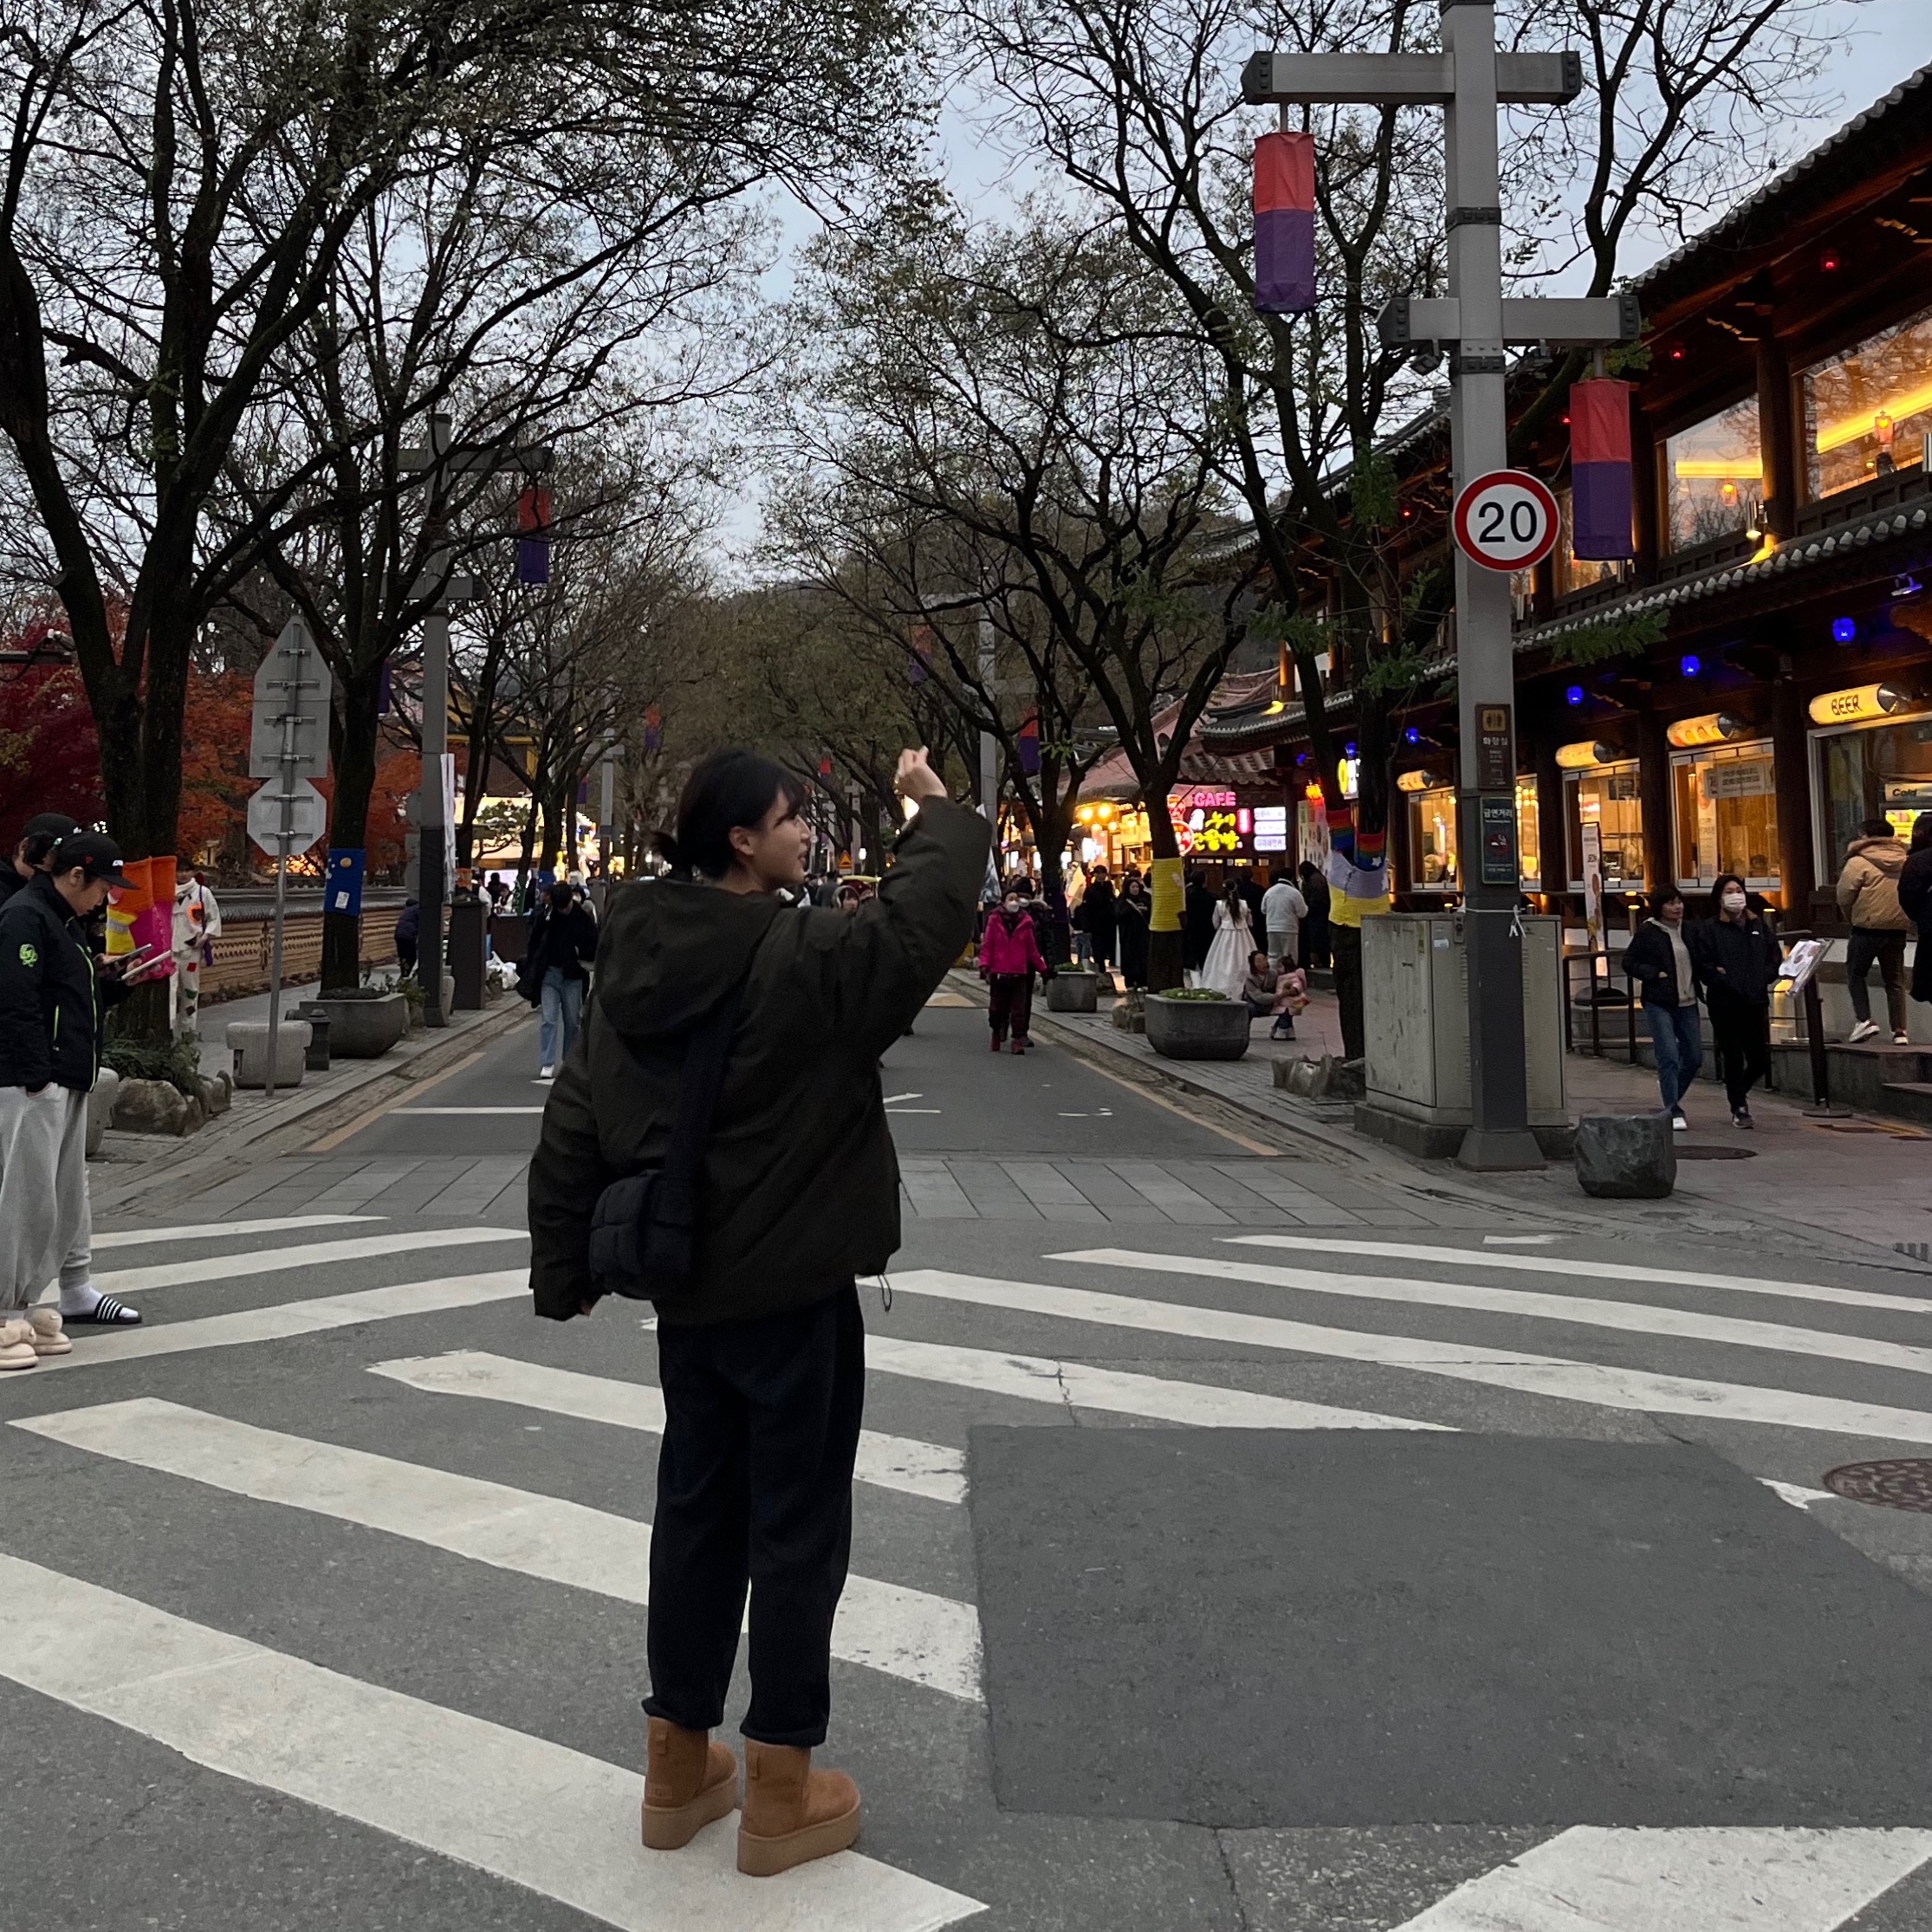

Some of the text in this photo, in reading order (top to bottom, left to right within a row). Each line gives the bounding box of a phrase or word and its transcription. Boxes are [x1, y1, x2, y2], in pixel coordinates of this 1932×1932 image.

[1478, 501, 1537, 543] 20
[1831, 694, 1864, 716] BEER
[1482, 736, 1508, 746] 화장실
[1194, 791, 1236, 807] CAFE
[1892, 788, 1917, 797] Cold
[1484, 808, 1513, 819] 금연거리
